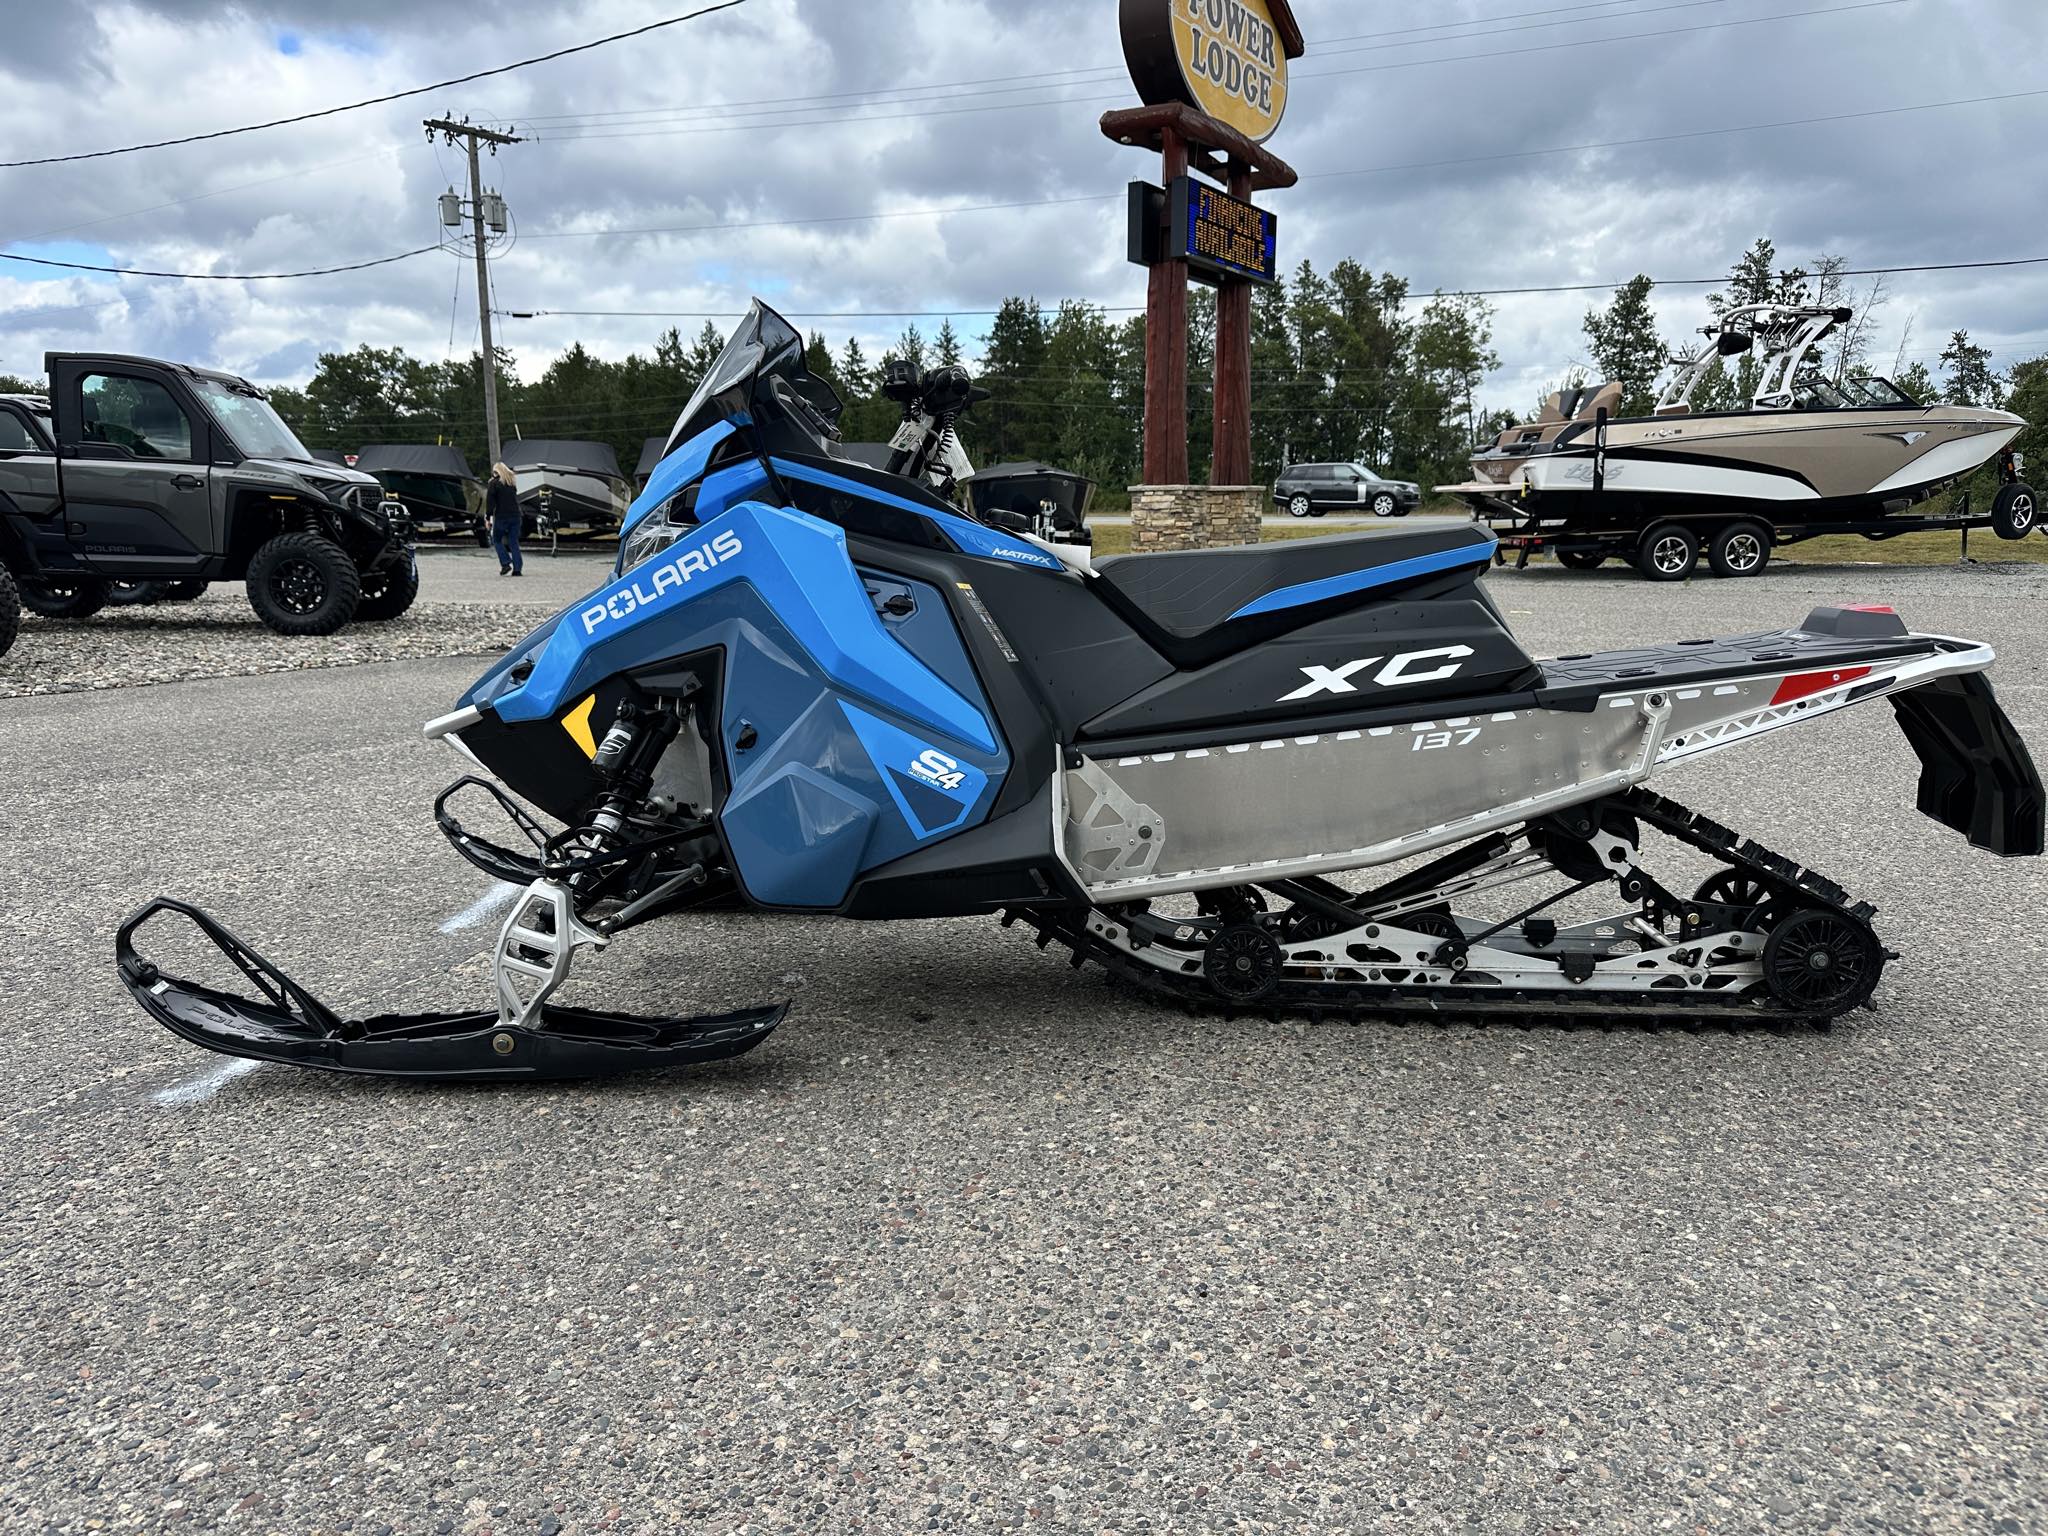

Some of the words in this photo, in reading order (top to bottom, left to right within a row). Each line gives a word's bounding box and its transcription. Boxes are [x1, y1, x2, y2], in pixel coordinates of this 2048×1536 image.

[1191, 27, 1273, 114] LODGE
[84, 545, 136, 553] POLARIS
[991, 547, 1052, 567] MATRYX
[581, 529, 743, 635] POLARIS
[1275, 644, 1475, 702] XC
[1411, 727, 1481, 751] 137
[911, 749, 968, 790] S4
